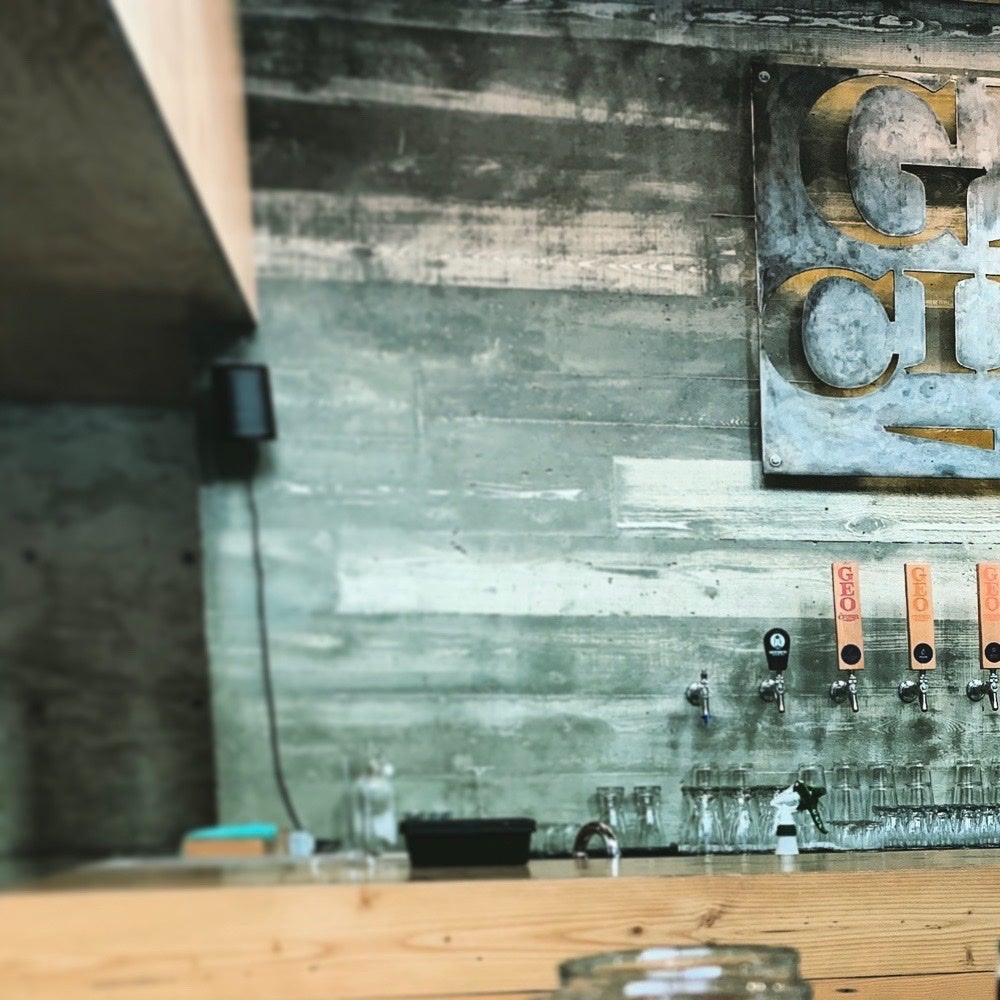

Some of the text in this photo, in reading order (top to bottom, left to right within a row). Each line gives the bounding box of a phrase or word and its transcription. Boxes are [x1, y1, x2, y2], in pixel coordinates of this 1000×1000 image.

[837, 566, 857, 612] GEO
[910, 567, 930, 612] GEO
[983, 567, 1000, 612] GEO
